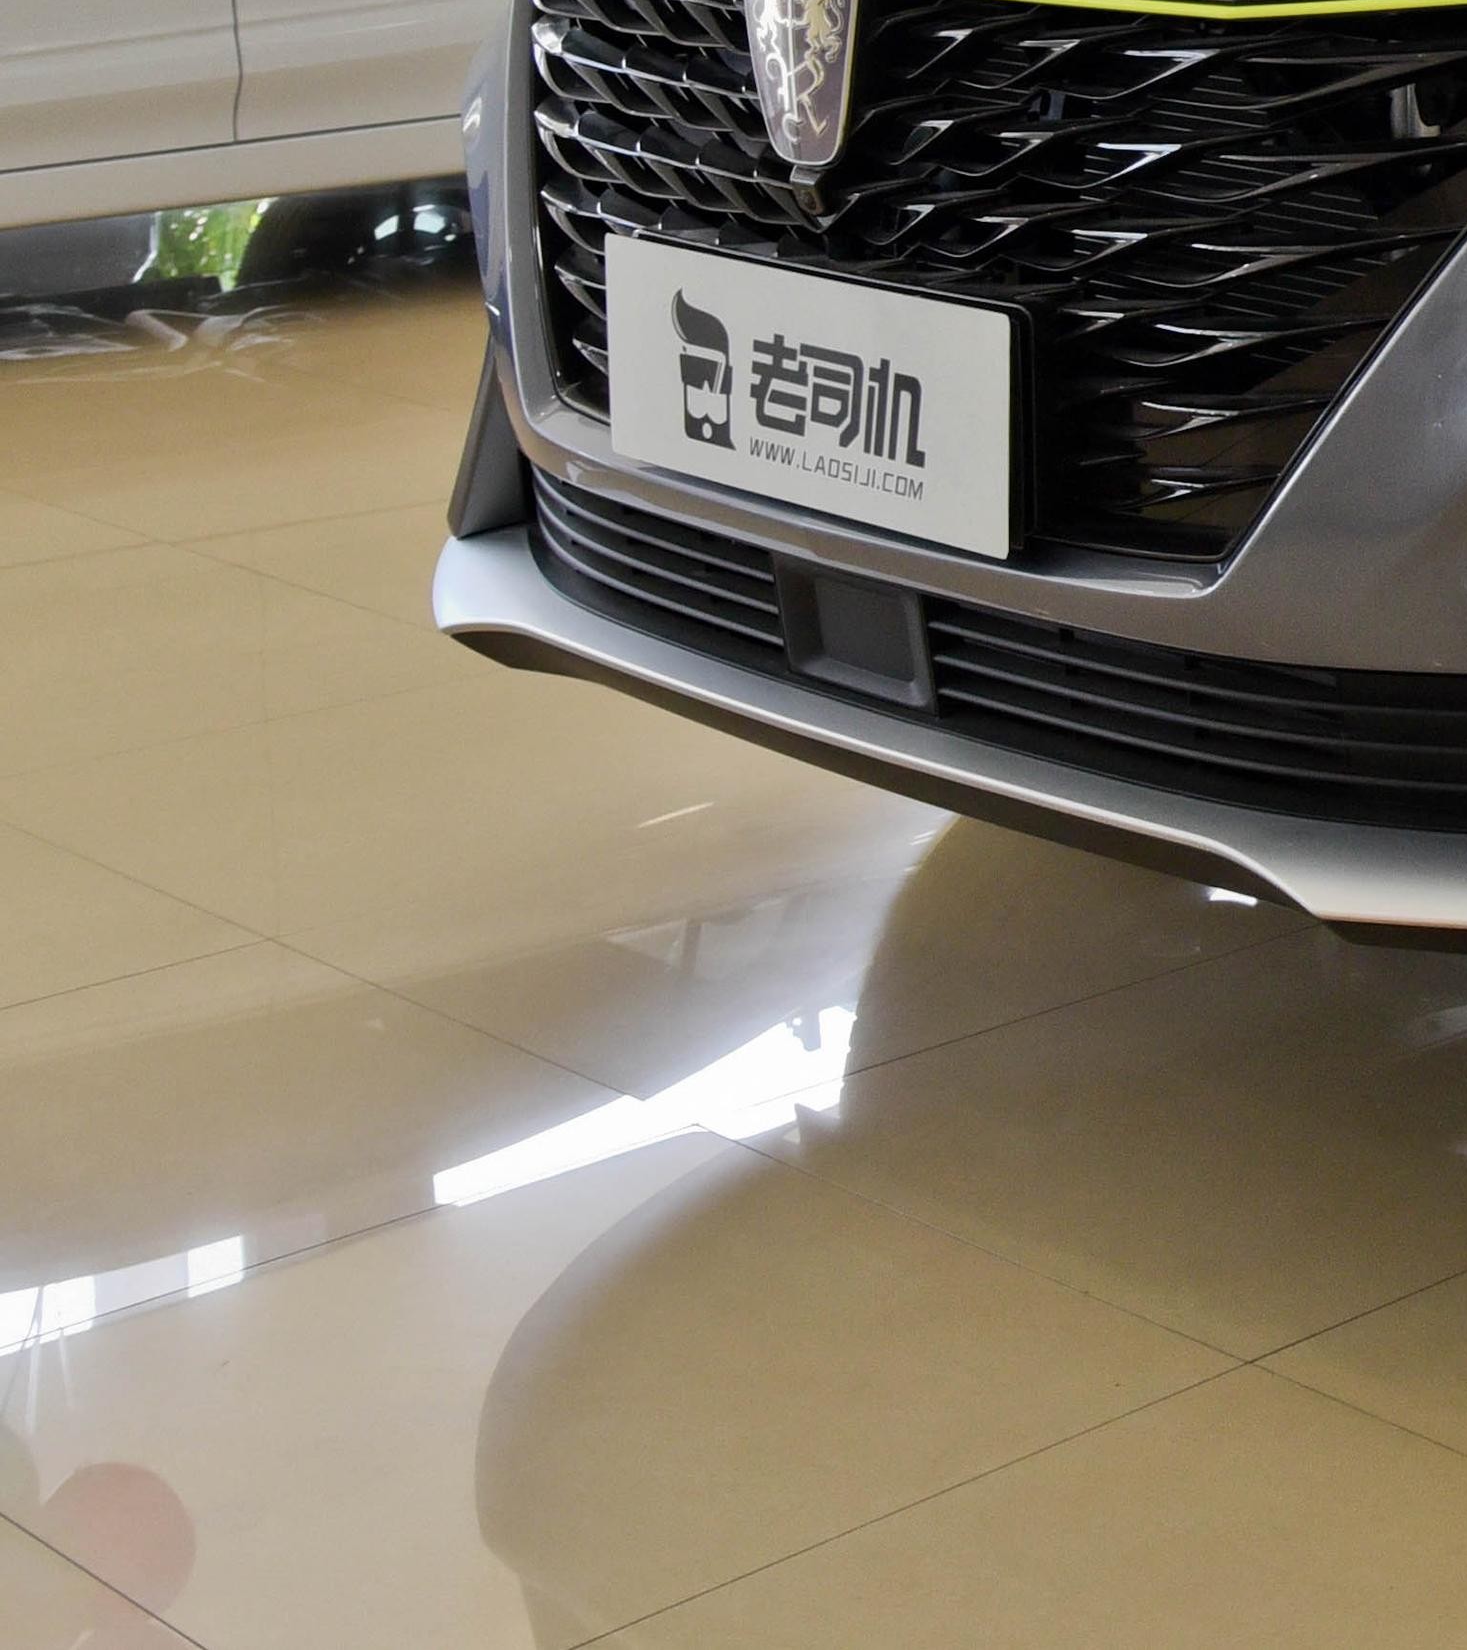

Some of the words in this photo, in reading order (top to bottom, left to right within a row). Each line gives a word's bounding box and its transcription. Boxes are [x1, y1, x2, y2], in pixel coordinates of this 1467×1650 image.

[749, 333, 926, 468] 老司机
[748, 436, 925, 501] WWW.LAOSIJI.COM
